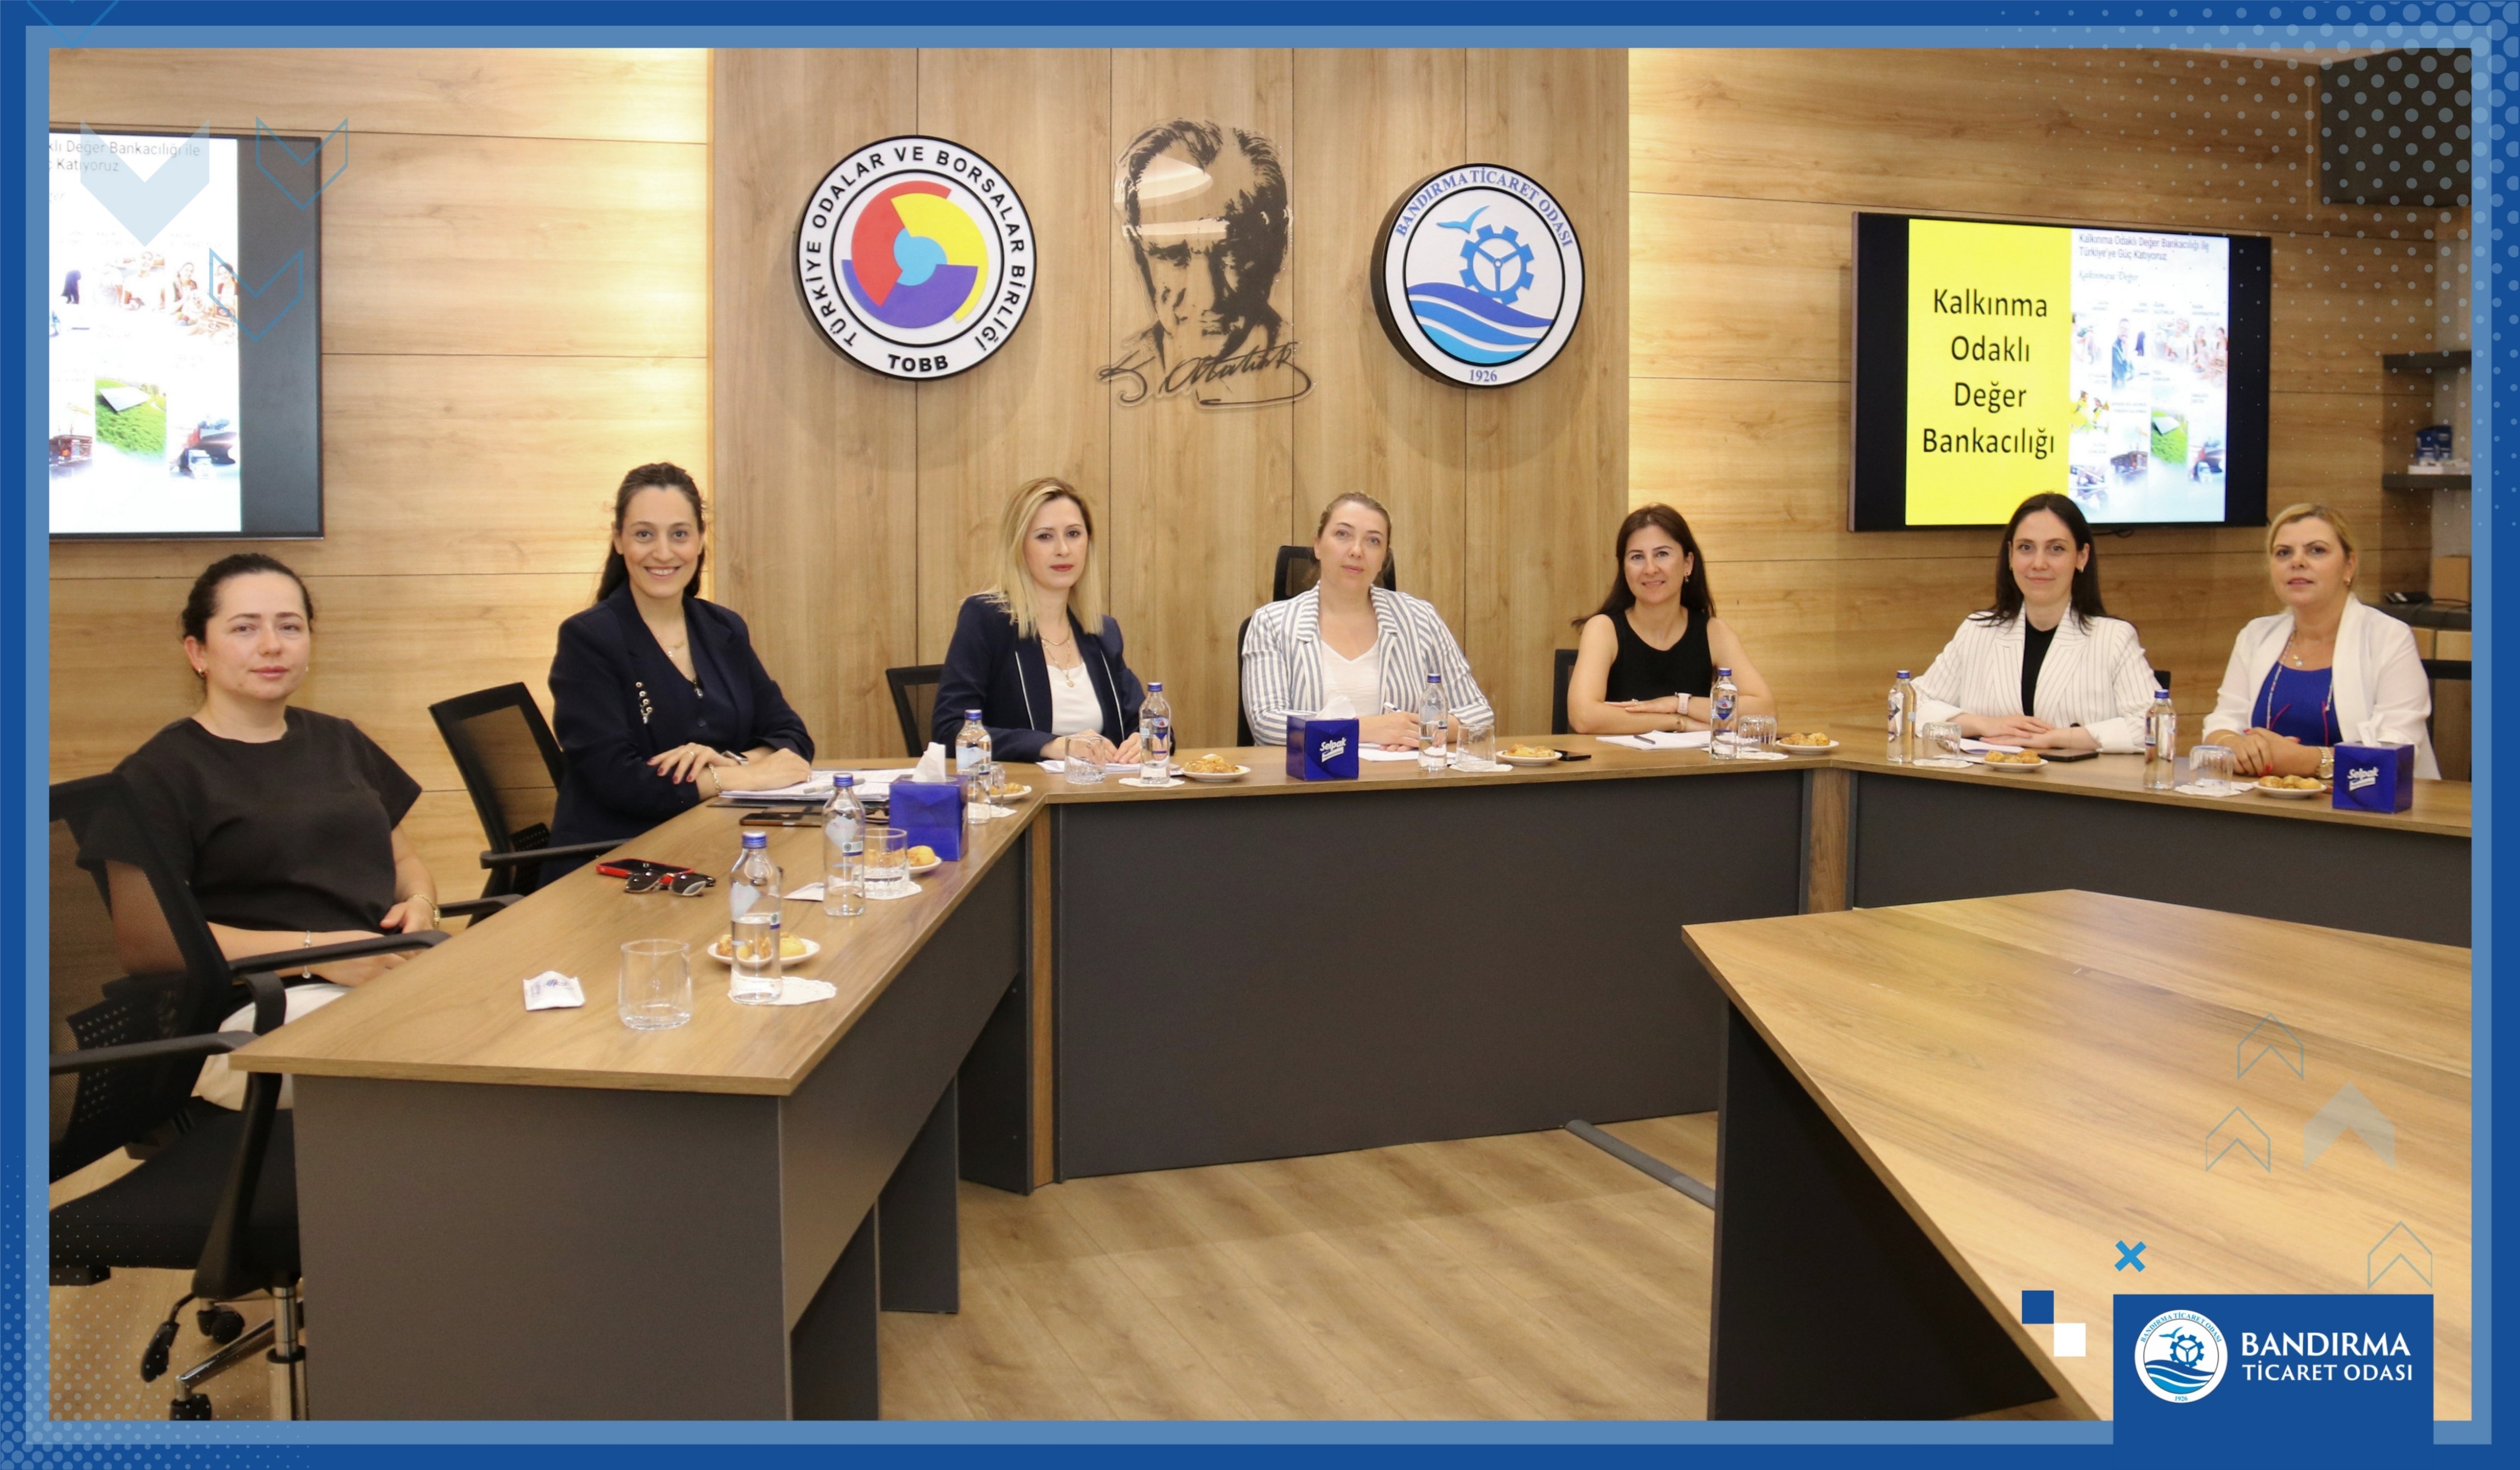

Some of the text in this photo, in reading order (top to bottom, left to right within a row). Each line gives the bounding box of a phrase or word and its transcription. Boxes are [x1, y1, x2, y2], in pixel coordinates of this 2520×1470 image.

[67, 141, 105, 155] Değer
[110, 142, 181, 158] Bankacılığı
[185, 143, 200, 156] ile
[57, 158, 119, 173] Katıyoruz
[1395, 167, 1573, 248] BANDIRMA TİCARET ODASI
[806, 146, 1026, 351] TÜRKİYE ODALAR VE BORSALAR BİRLİĞİ
[1935, 288, 2047, 317] Kalkınma
[1952, 335, 2029, 362] Odaklı
[888, 354, 948, 372] TOBB
[1469, 369, 1498, 382] 1926
[1955, 381, 2027, 413] Değer
[1923, 427, 2053, 459] Bankacılığı
[1319, 737, 1346, 751] Selpak
[2346, 767, 2379, 780] Selpak
